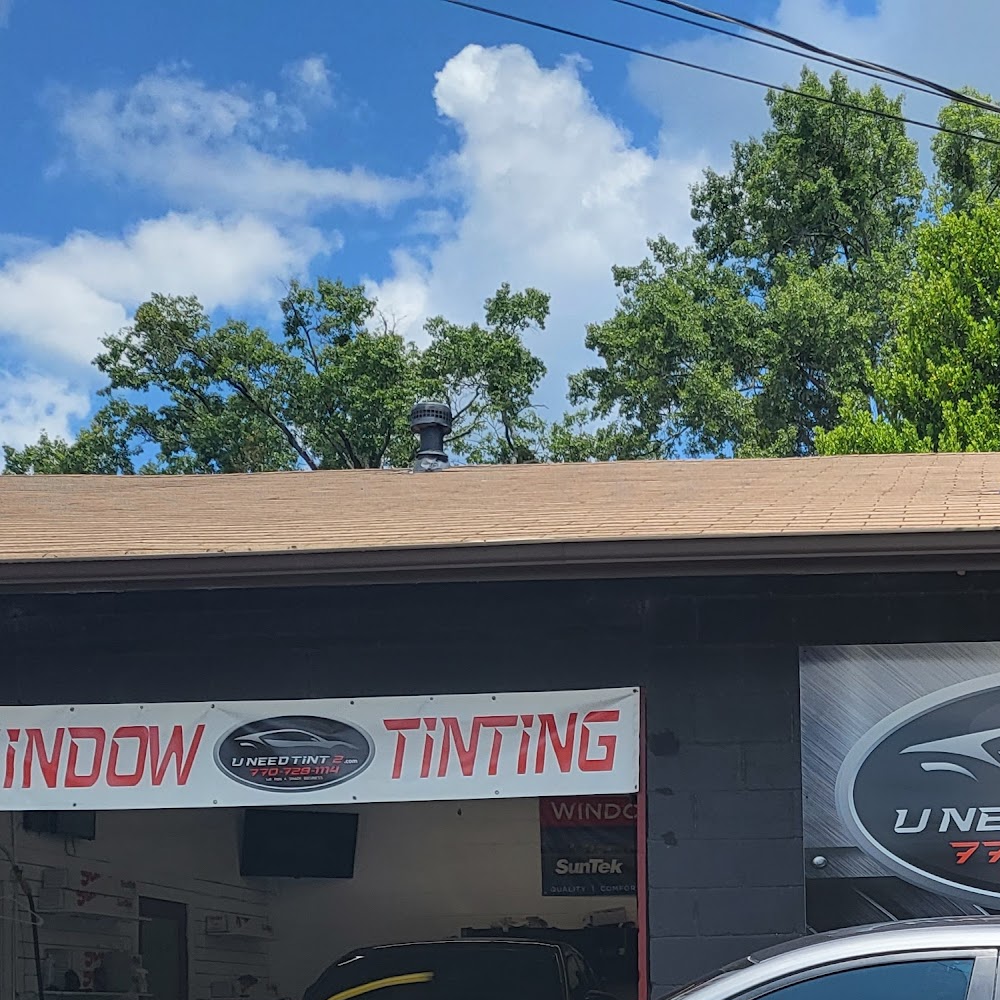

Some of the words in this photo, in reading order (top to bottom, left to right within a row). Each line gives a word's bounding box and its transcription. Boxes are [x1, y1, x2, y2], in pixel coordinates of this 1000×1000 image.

[231, 757, 244, 767] U
[332, 755, 344, 764] 2
[249, 766, 340, 777] 770-728-1114
[893, 808, 932, 834] U
[555, 858, 623, 875] SunTek
[550, 885, 587, 893] QUALITY
